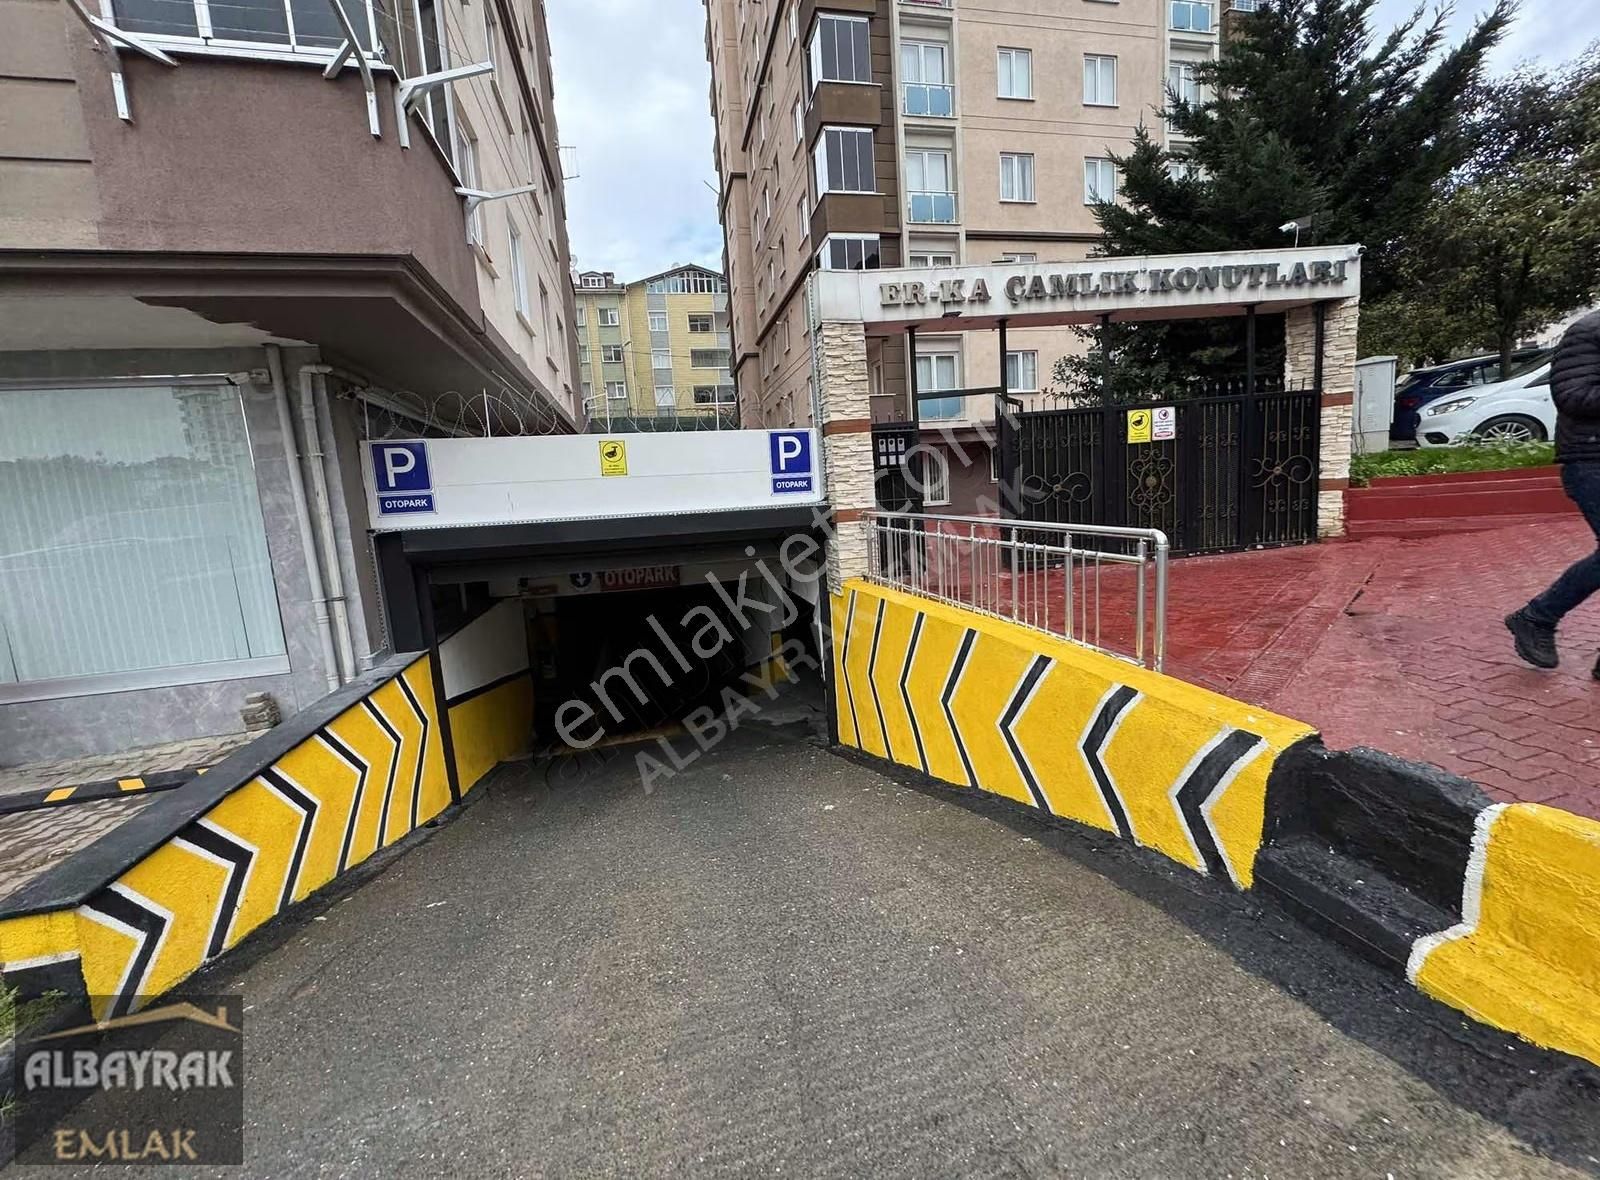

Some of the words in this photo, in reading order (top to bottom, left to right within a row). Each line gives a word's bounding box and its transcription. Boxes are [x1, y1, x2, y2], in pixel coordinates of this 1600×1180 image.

[879, 278, 992, 306] ER-KA
[1004, 269, 1142, 305] ÇAMLIK
[1148, 259, 1348, 292] KONUTLARI
[779, 436, 802, 470] P
[384, 447, 416, 488] P
[776, 480, 808, 489] OTOPARK
[384, 498, 428, 509] OTOPARK
[604, 566, 675, 586] OTOPARK
